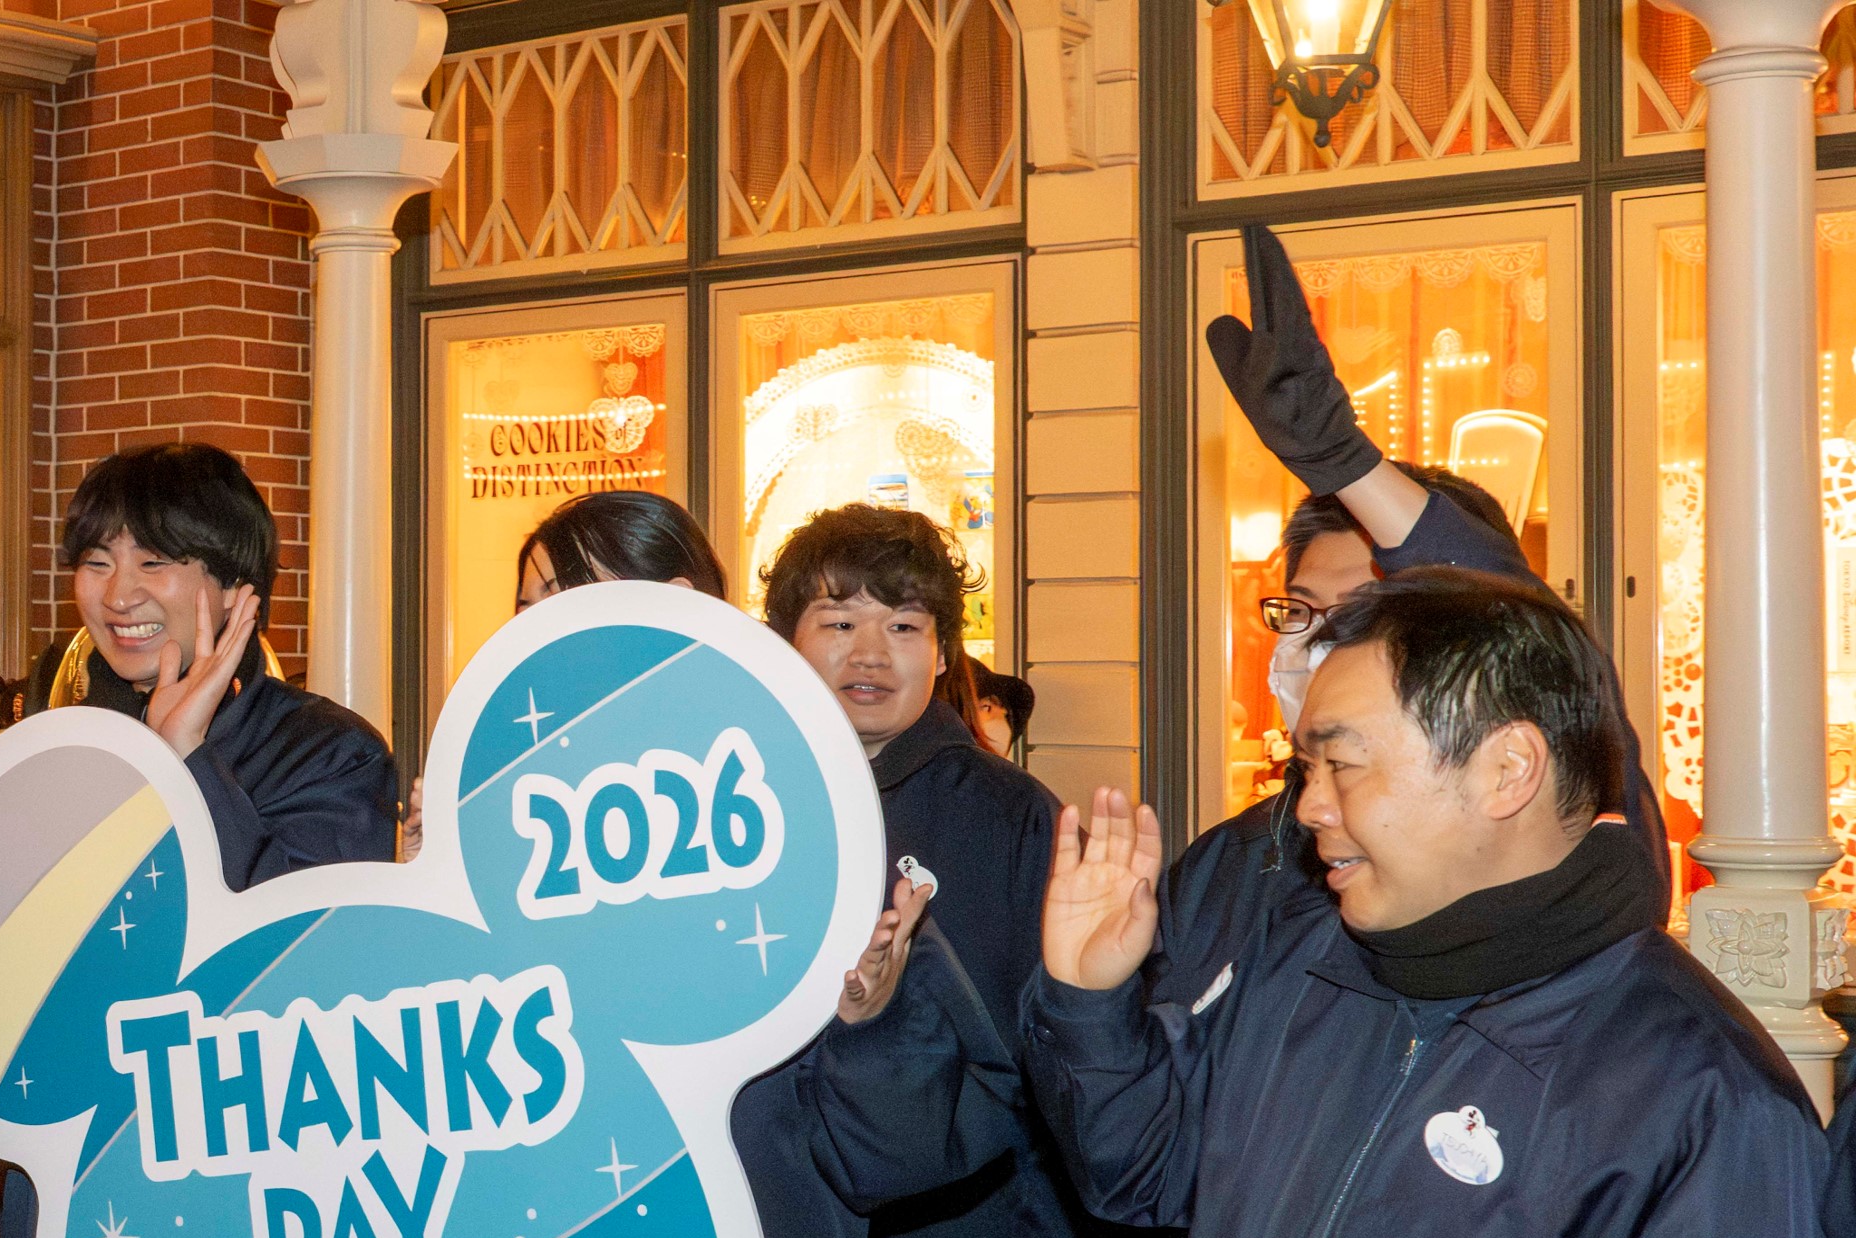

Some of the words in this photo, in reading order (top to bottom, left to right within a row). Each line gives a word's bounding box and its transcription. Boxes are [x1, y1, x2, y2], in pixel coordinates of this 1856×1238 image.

[472, 456, 643, 499] DISTINCTION
[490, 419, 606, 457] COOKIES
[528, 749, 766, 899] 2026
[120, 985, 567, 1163] THANKS
